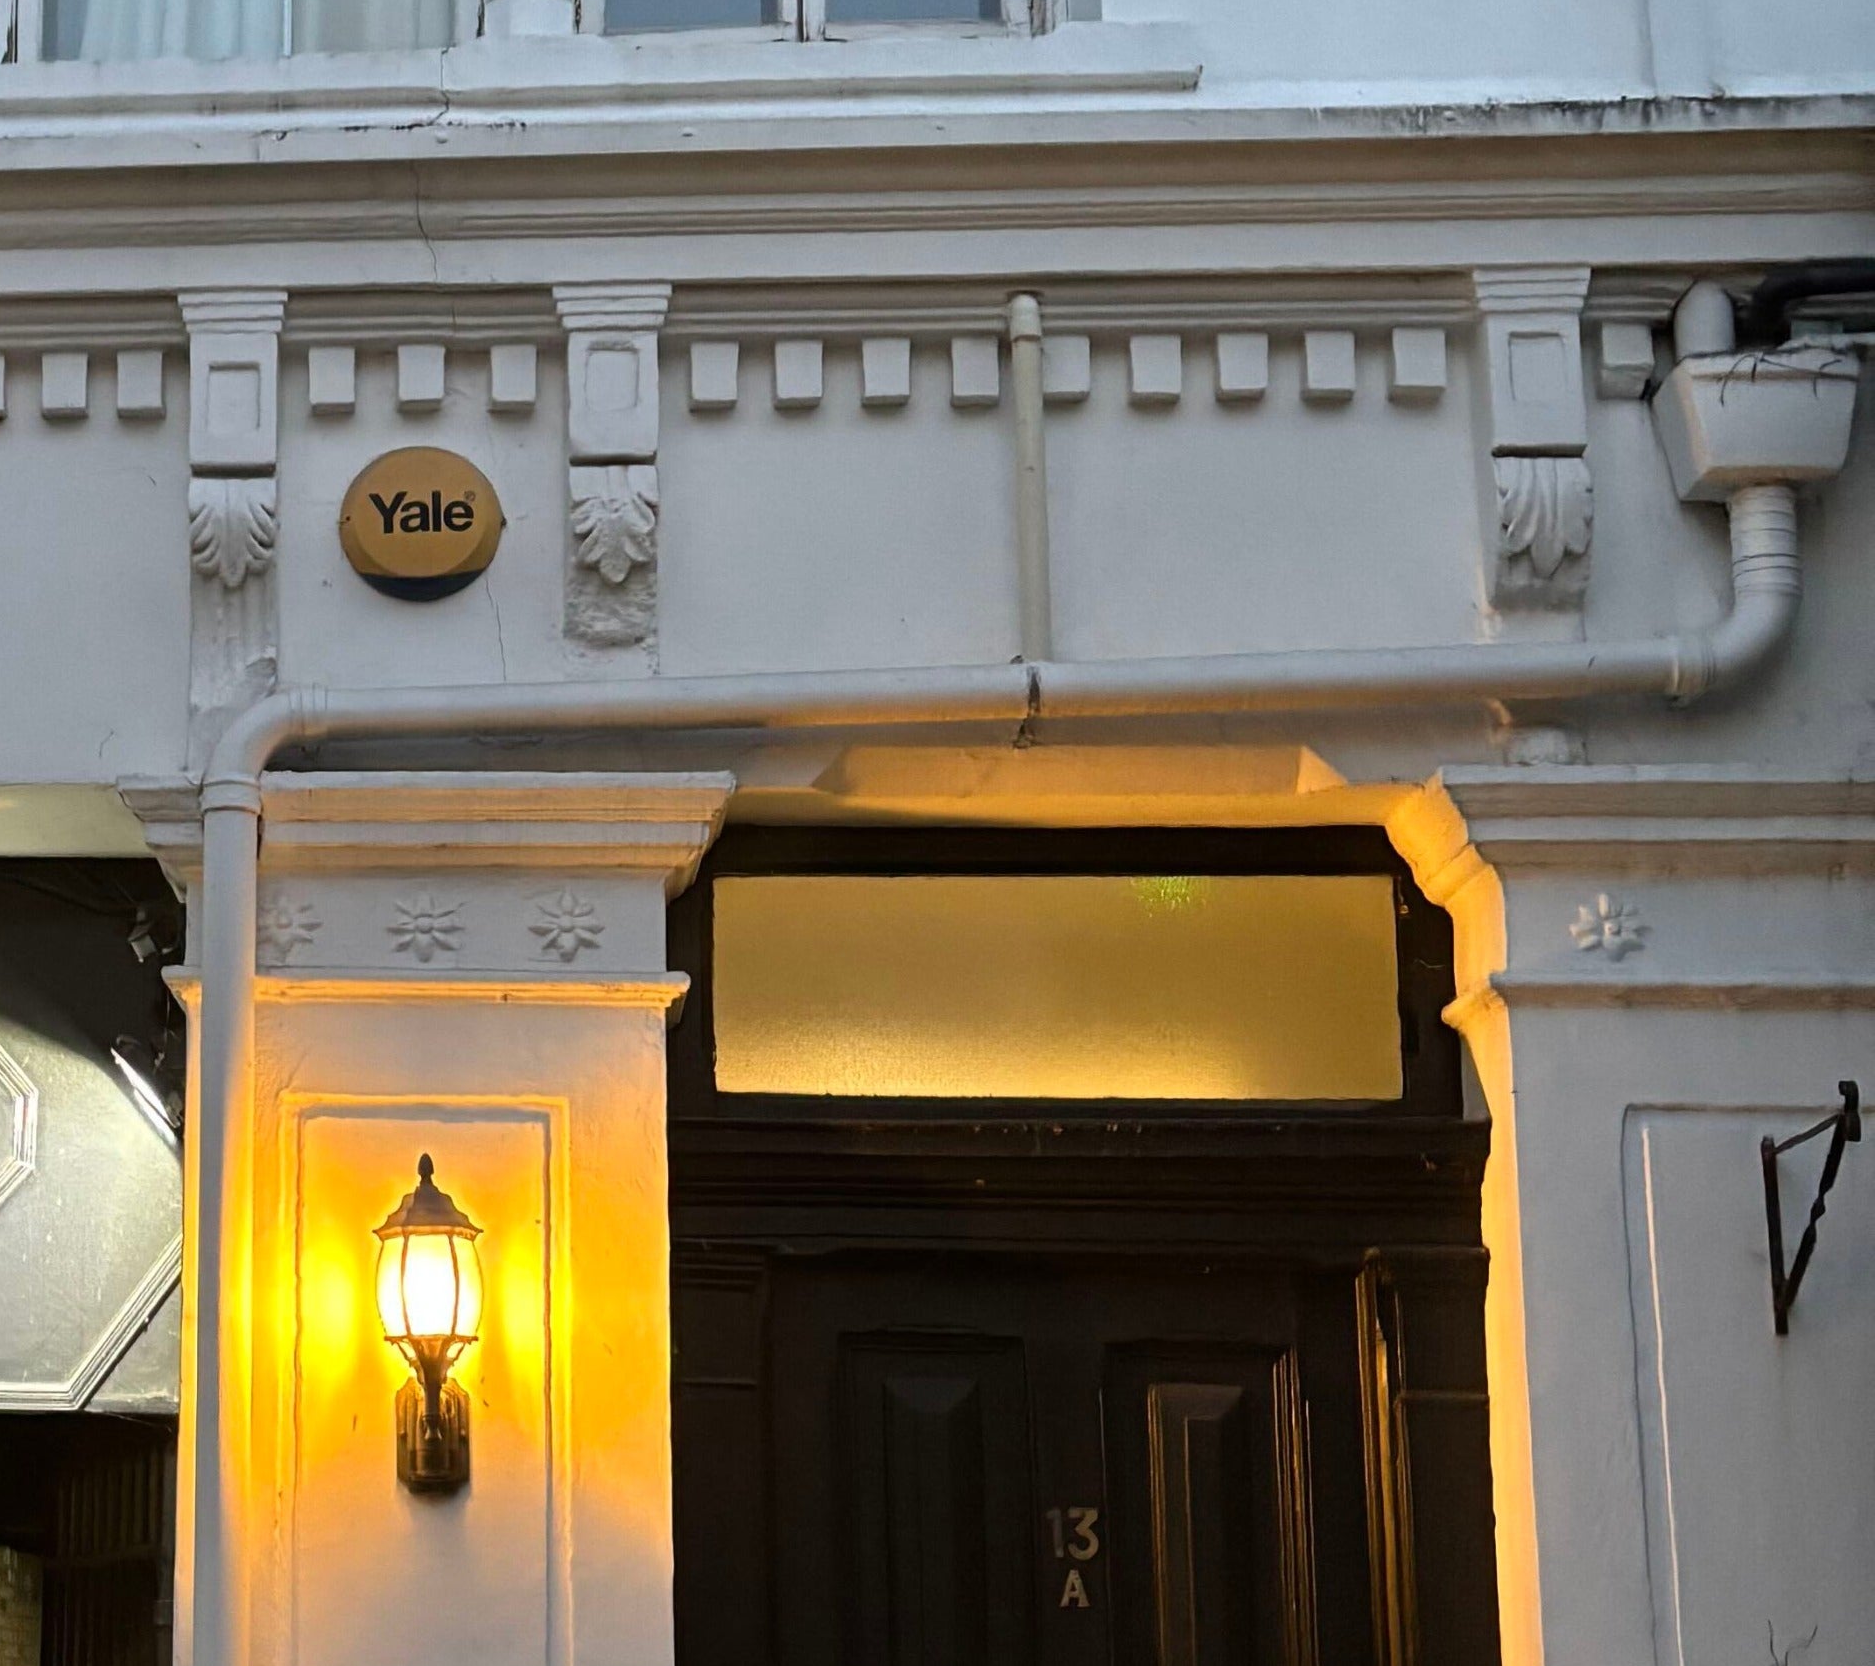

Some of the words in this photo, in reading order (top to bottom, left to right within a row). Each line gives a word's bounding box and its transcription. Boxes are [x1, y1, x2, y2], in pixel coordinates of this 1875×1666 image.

[368, 490, 474, 535] Yale
[1044, 1507, 1100, 1561] 13
[1059, 1569, 1091, 1608] A
